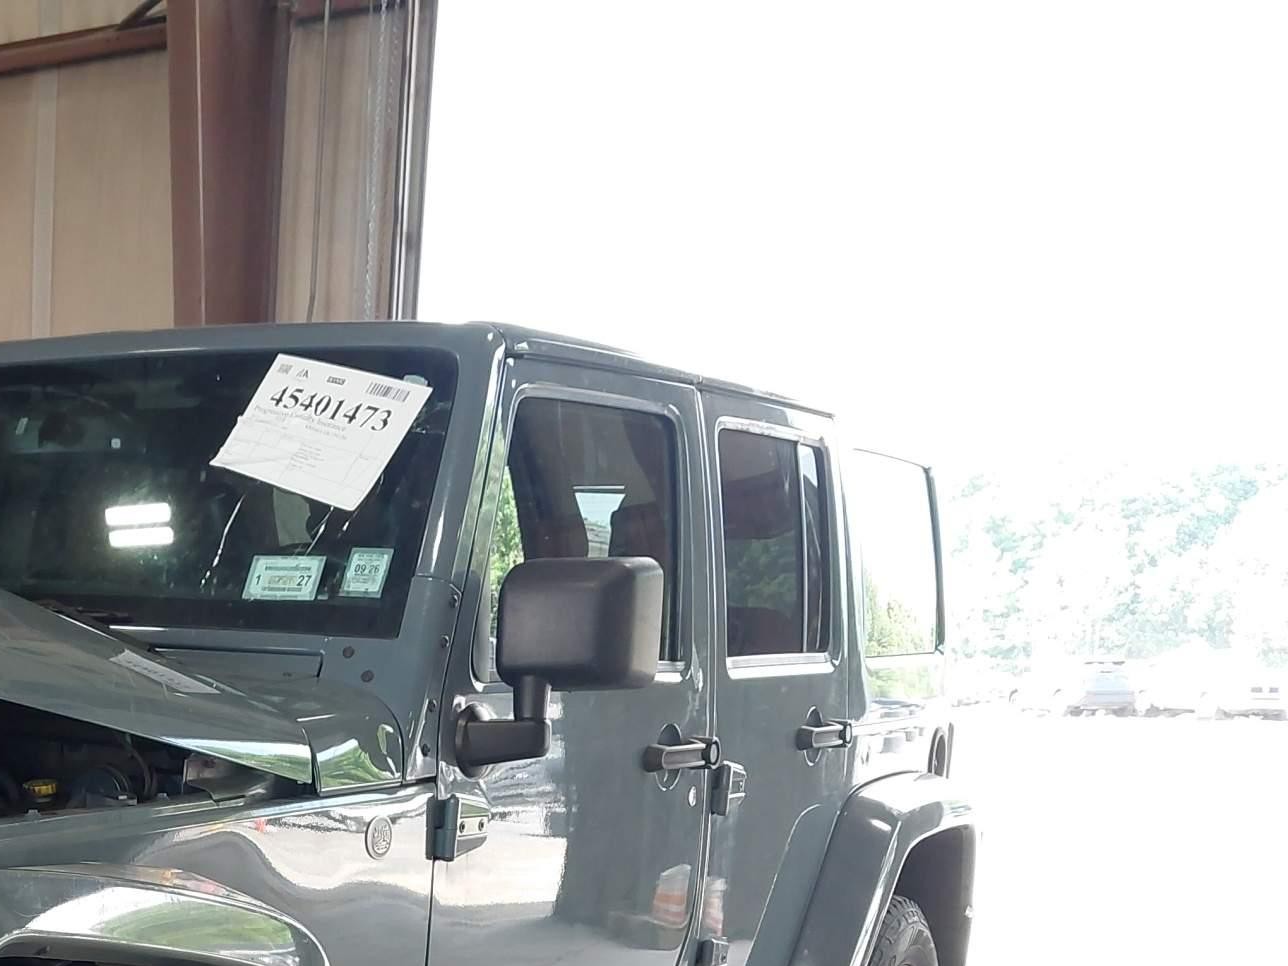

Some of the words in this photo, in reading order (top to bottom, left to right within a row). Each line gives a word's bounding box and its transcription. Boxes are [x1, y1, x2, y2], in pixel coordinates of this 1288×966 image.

[269, 385, 394, 432] 45401473
[354, 563, 367, 575] 09
[255, 574, 262, 586] 1
[296, 574, 312, 587] 27
